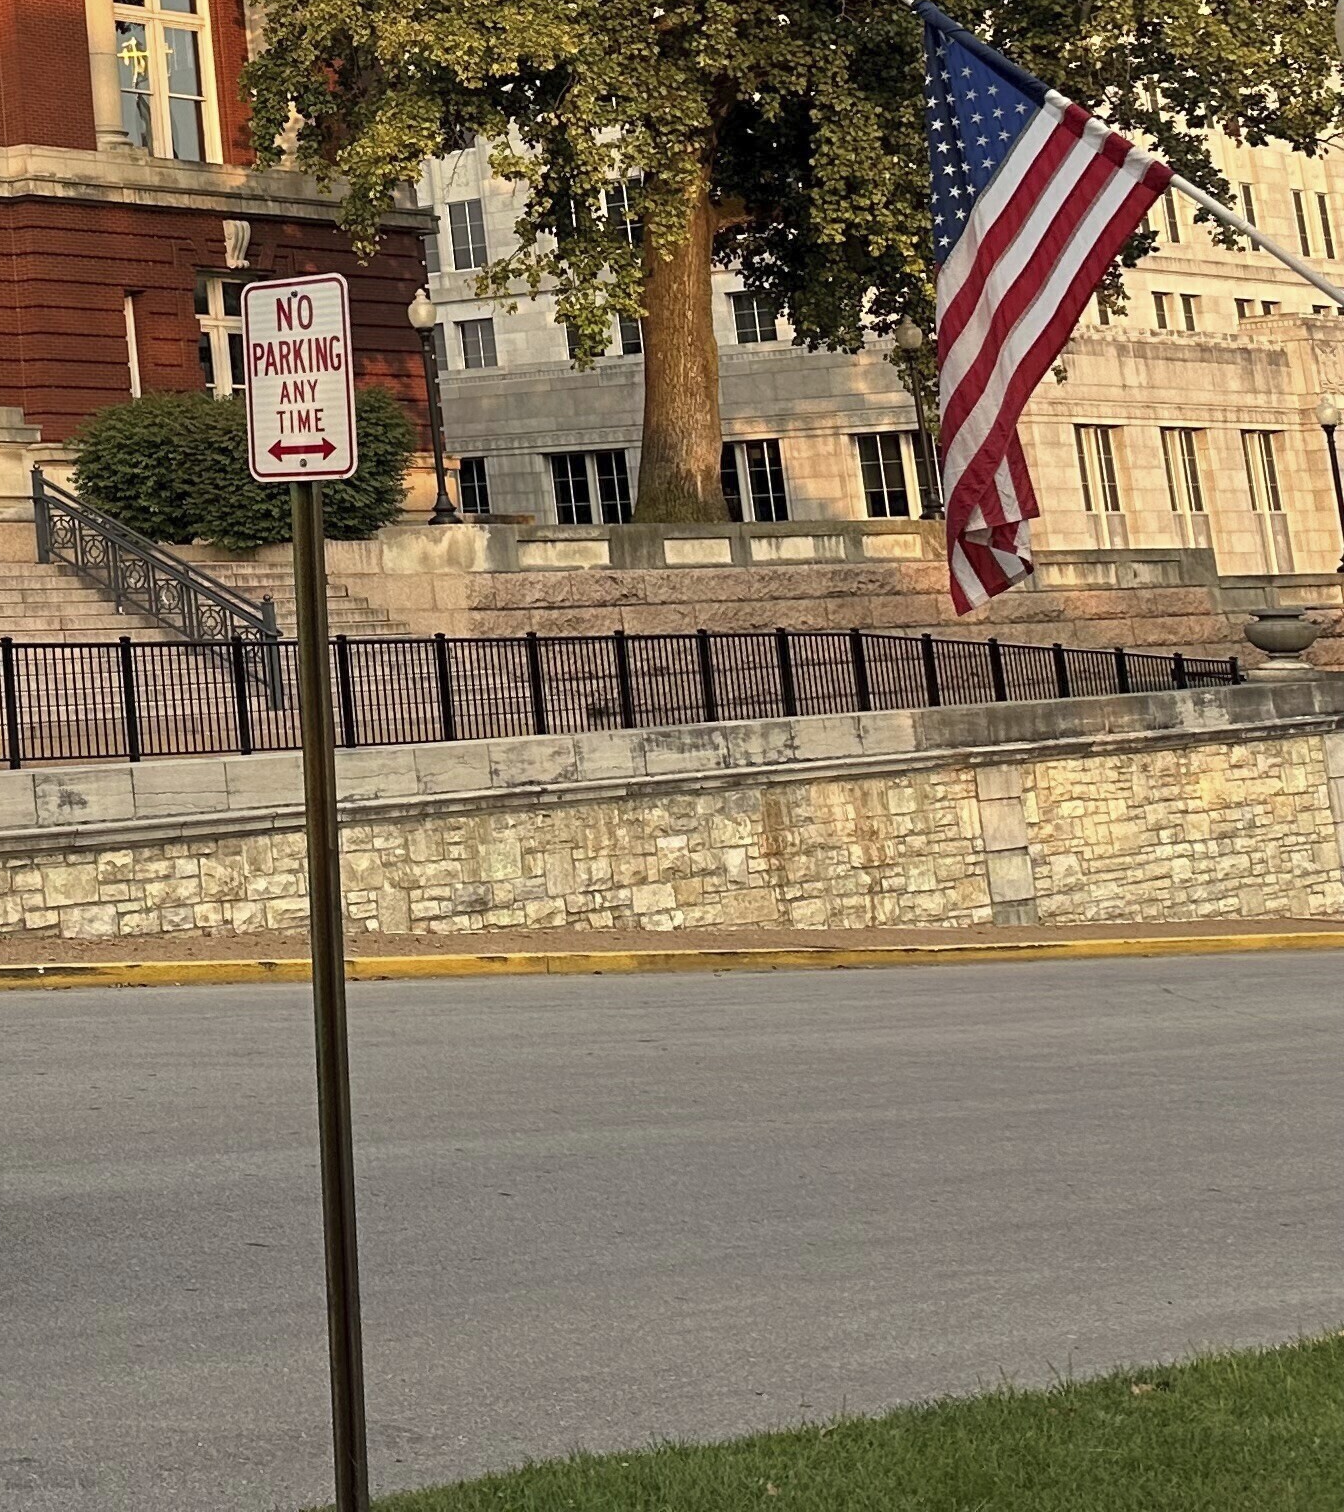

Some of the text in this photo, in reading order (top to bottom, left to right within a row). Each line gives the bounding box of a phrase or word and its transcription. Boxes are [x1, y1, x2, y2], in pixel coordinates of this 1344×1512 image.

[275, 293, 314, 333] NO
[252, 335, 342, 378] PARKING
[279, 378, 319, 405] ANY
[276, 408, 326, 435] TIME
